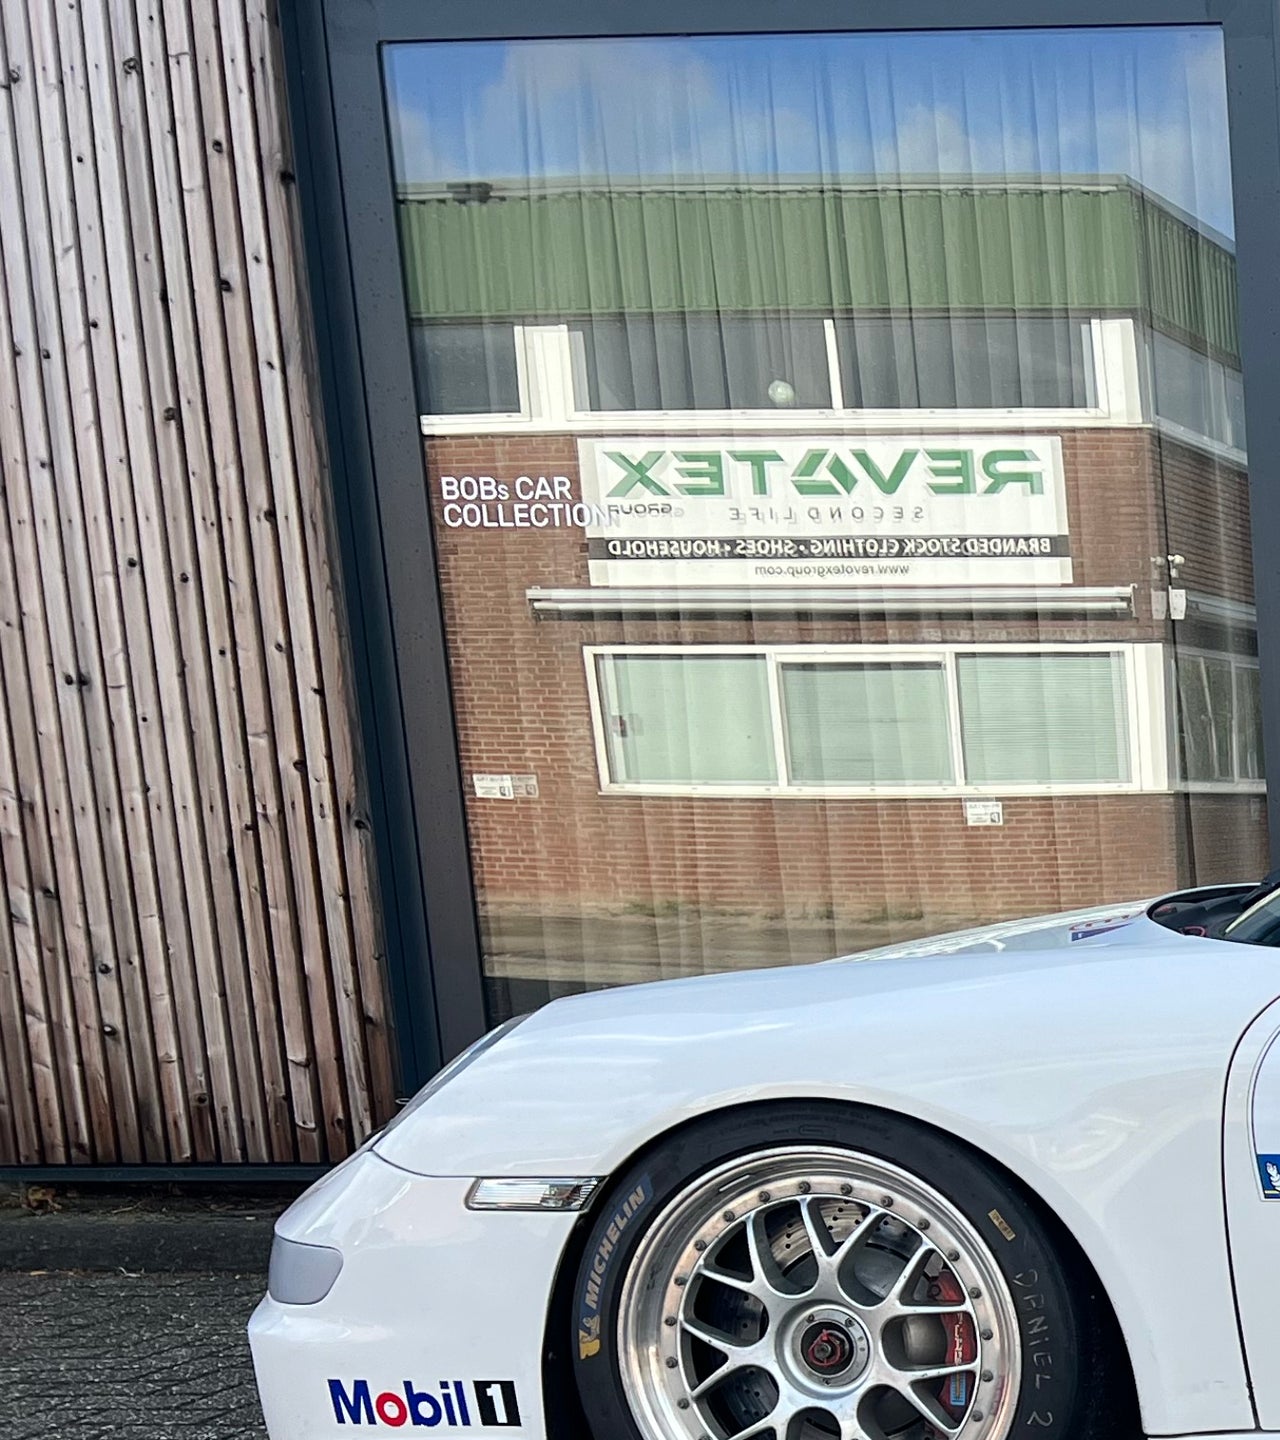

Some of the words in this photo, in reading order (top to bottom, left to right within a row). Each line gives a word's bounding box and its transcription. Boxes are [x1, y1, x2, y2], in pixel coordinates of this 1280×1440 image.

[441, 476, 510, 501] BOBs
[515, 476, 572, 501] CAR
[444, 503, 613, 528] COLLECTION
[585, 1185, 646, 1310] MICHELIN
[327, 1379, 471, 1427] Mobil
[486, 1382, 510, 1424] 1
